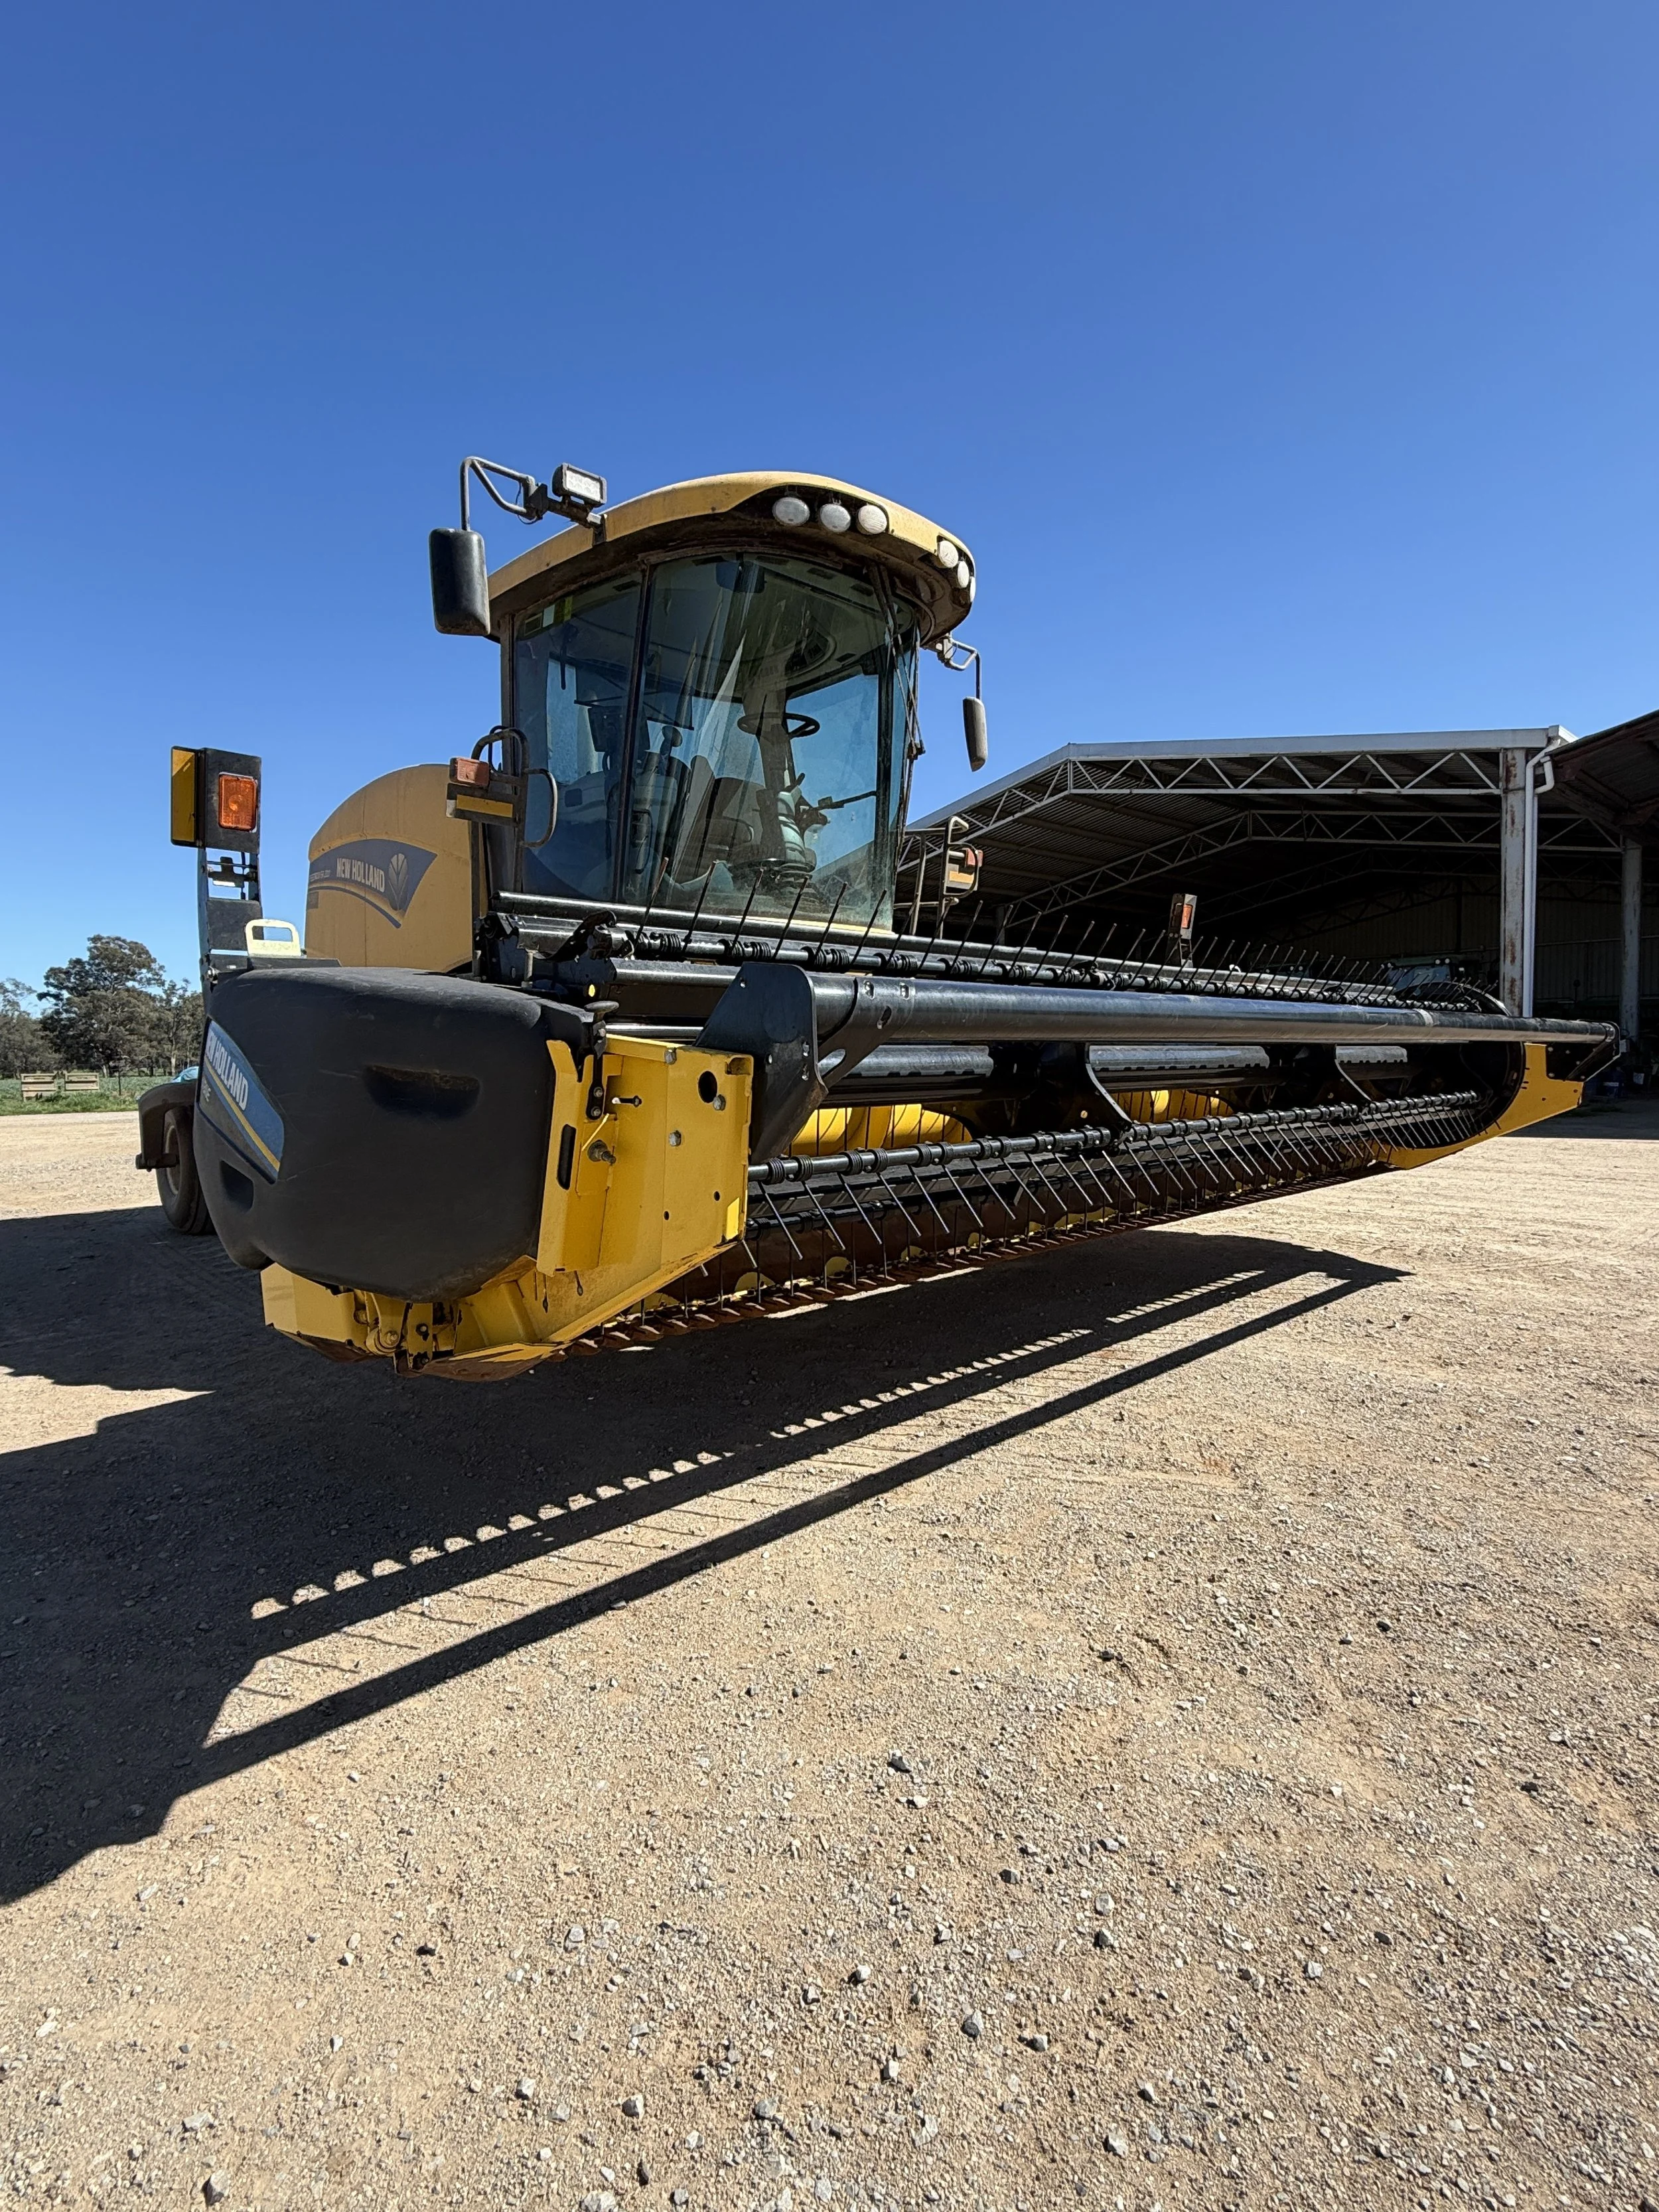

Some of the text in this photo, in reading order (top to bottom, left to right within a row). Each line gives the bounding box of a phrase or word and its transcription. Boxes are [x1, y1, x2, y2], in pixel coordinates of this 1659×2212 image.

[336, 857, 351, 879] NEW
[352, 859, 385, 893] HOLLAND
[205, 1027, 218, 1063] EW
[212, 1040, 248, 1111] HOLLAND
